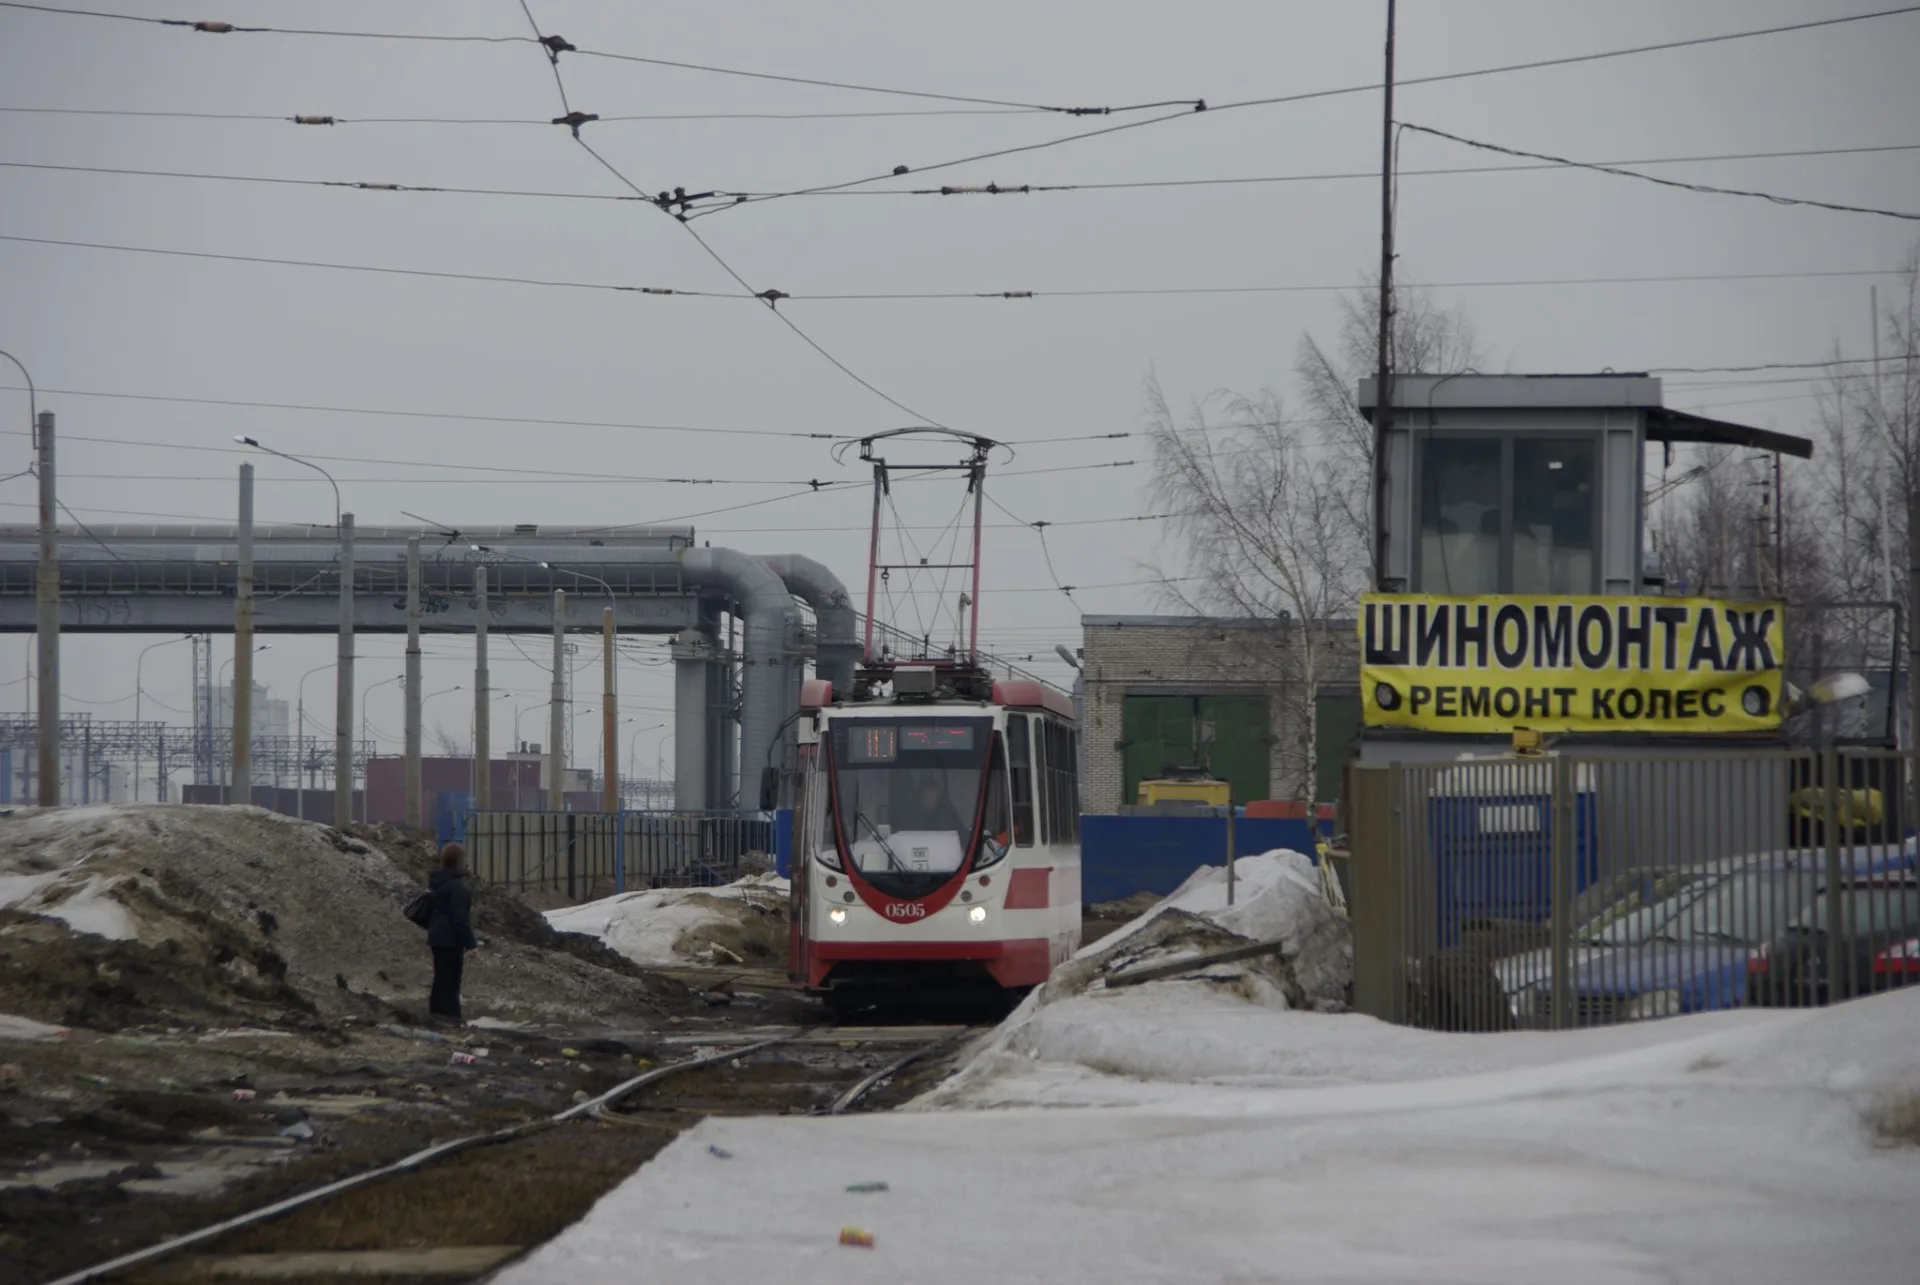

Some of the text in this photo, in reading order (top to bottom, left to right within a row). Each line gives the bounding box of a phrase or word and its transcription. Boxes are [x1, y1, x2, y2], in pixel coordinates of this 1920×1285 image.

[1365, 603, 1776, 671] ШИНОМОНТАЖ
[1410, 686, 1726, 719] РЕМОНТ КОЛЕС
[885, 903, 926, 917] 0505
